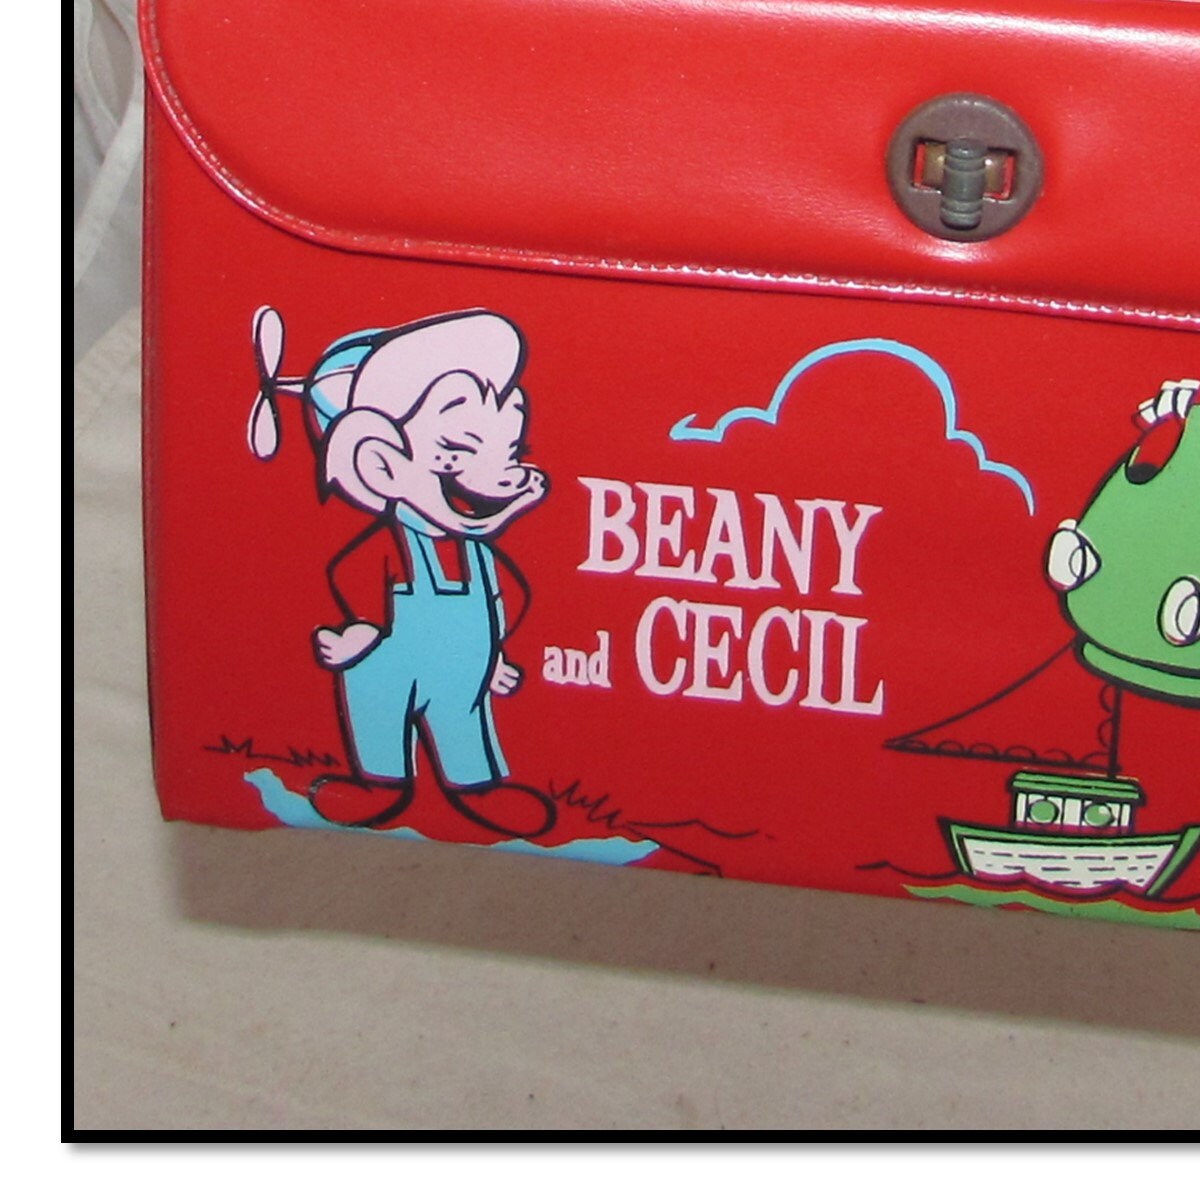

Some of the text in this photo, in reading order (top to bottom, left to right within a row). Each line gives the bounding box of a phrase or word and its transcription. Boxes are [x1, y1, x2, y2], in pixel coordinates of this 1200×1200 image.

[577, 477, 883, 595] BEANY
[543, 596, 884, 715] and CECIL
